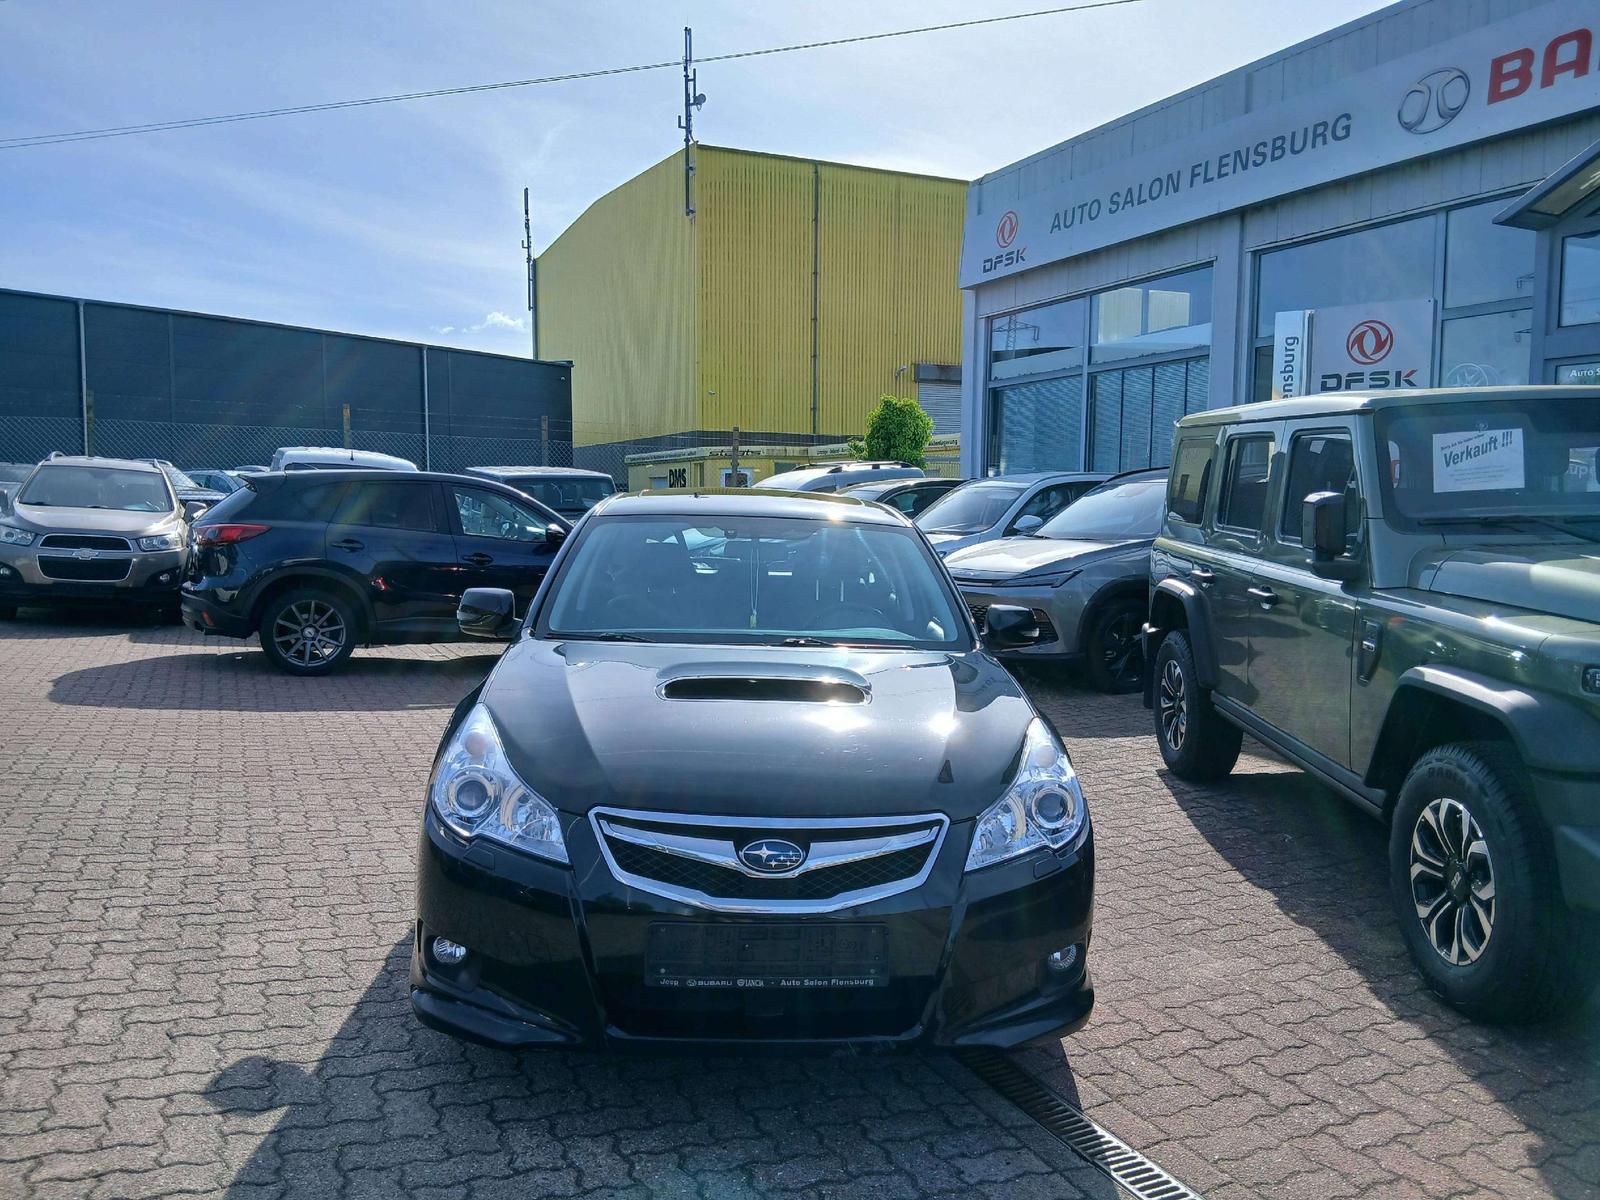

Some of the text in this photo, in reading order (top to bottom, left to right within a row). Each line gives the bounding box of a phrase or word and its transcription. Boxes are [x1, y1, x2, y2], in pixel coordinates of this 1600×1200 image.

[1487, 27, 1600, 105] BA
[1050, 112, 1352, 234] AUTO SALON FLENSBURG
[982, 247, 1027, 274] DFSK
[1320, 369, 1417, 392] DFSK
[1443, 435, 1498, 468] Verkauft
[1501, 430, 1513, 447] !!!
[668, 468, 687, 488] DMS
[660, 978, 679, 987] Jeep
[831, 978, 874, 987] Flensburg
